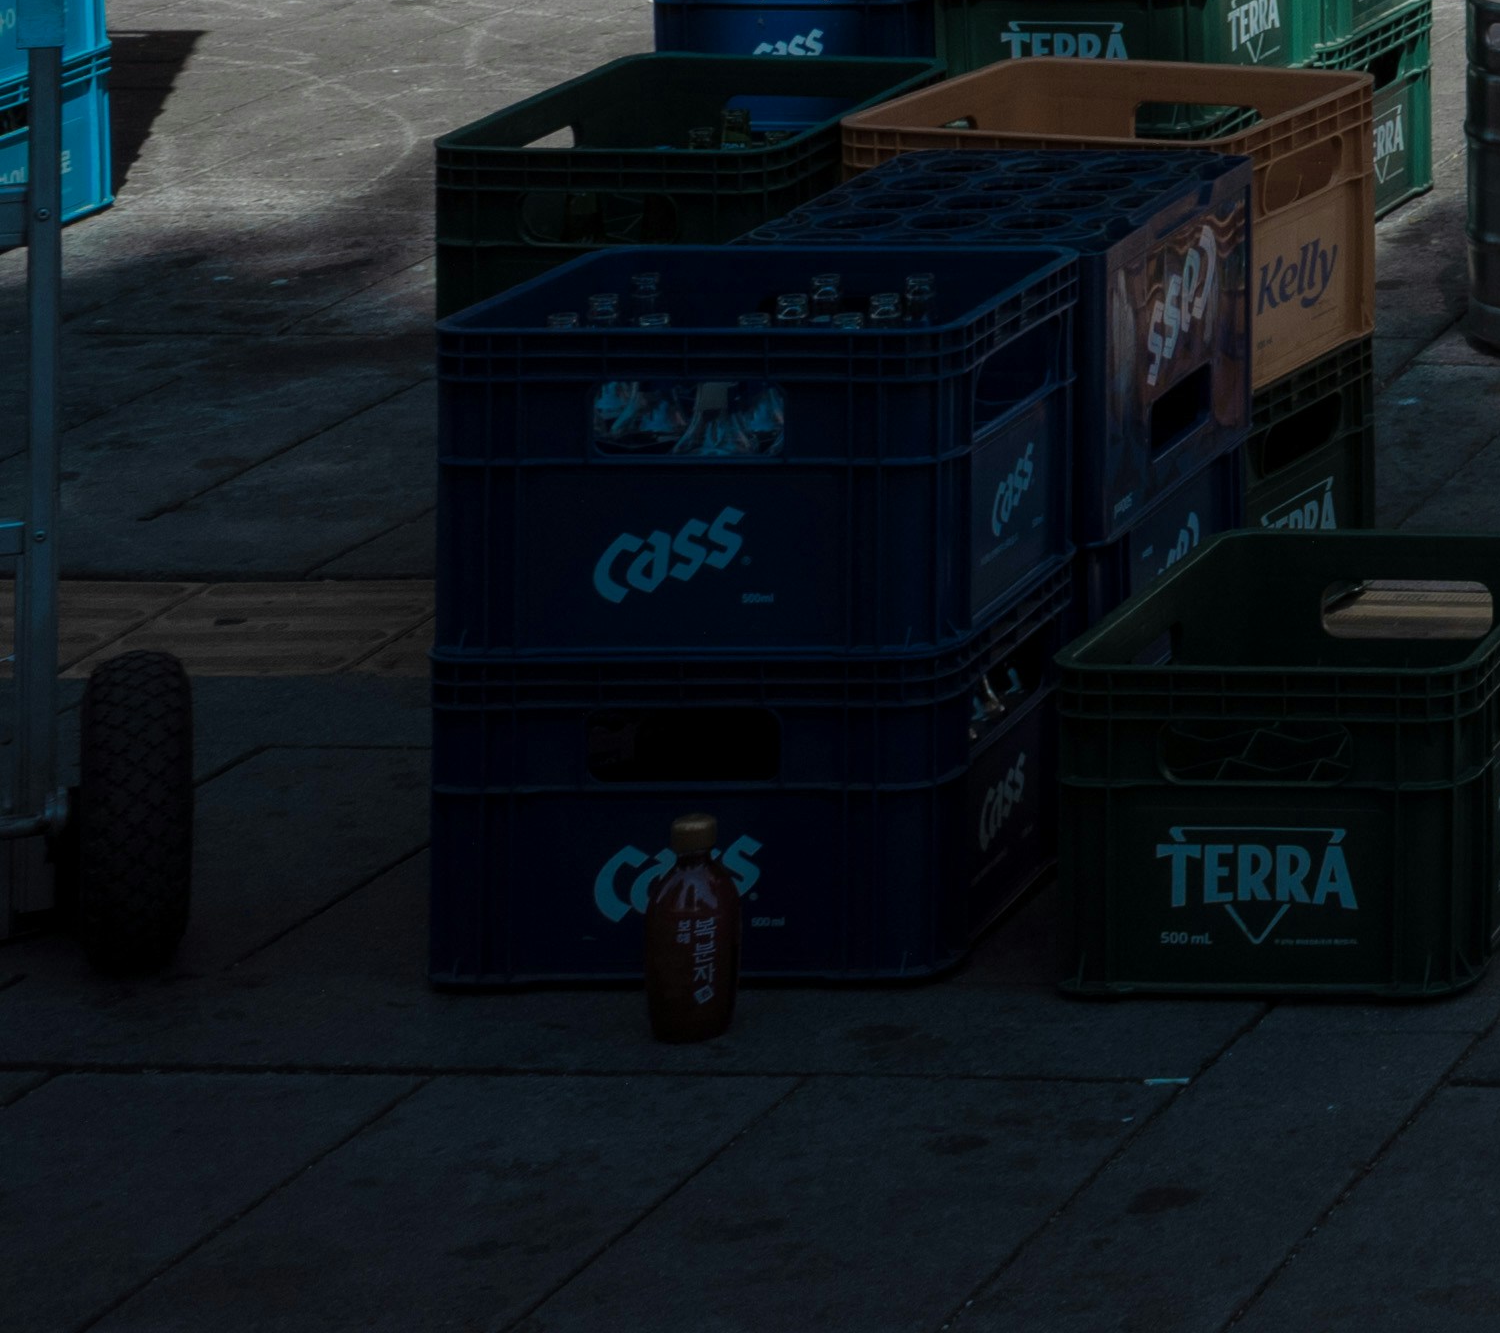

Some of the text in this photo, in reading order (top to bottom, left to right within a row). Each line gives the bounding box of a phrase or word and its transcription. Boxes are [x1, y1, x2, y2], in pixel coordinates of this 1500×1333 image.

[1257, 239, 1338, 315] Kelly
[592, 506, 748, 604] Cass
[1159, 931, 1188, 946] 500
